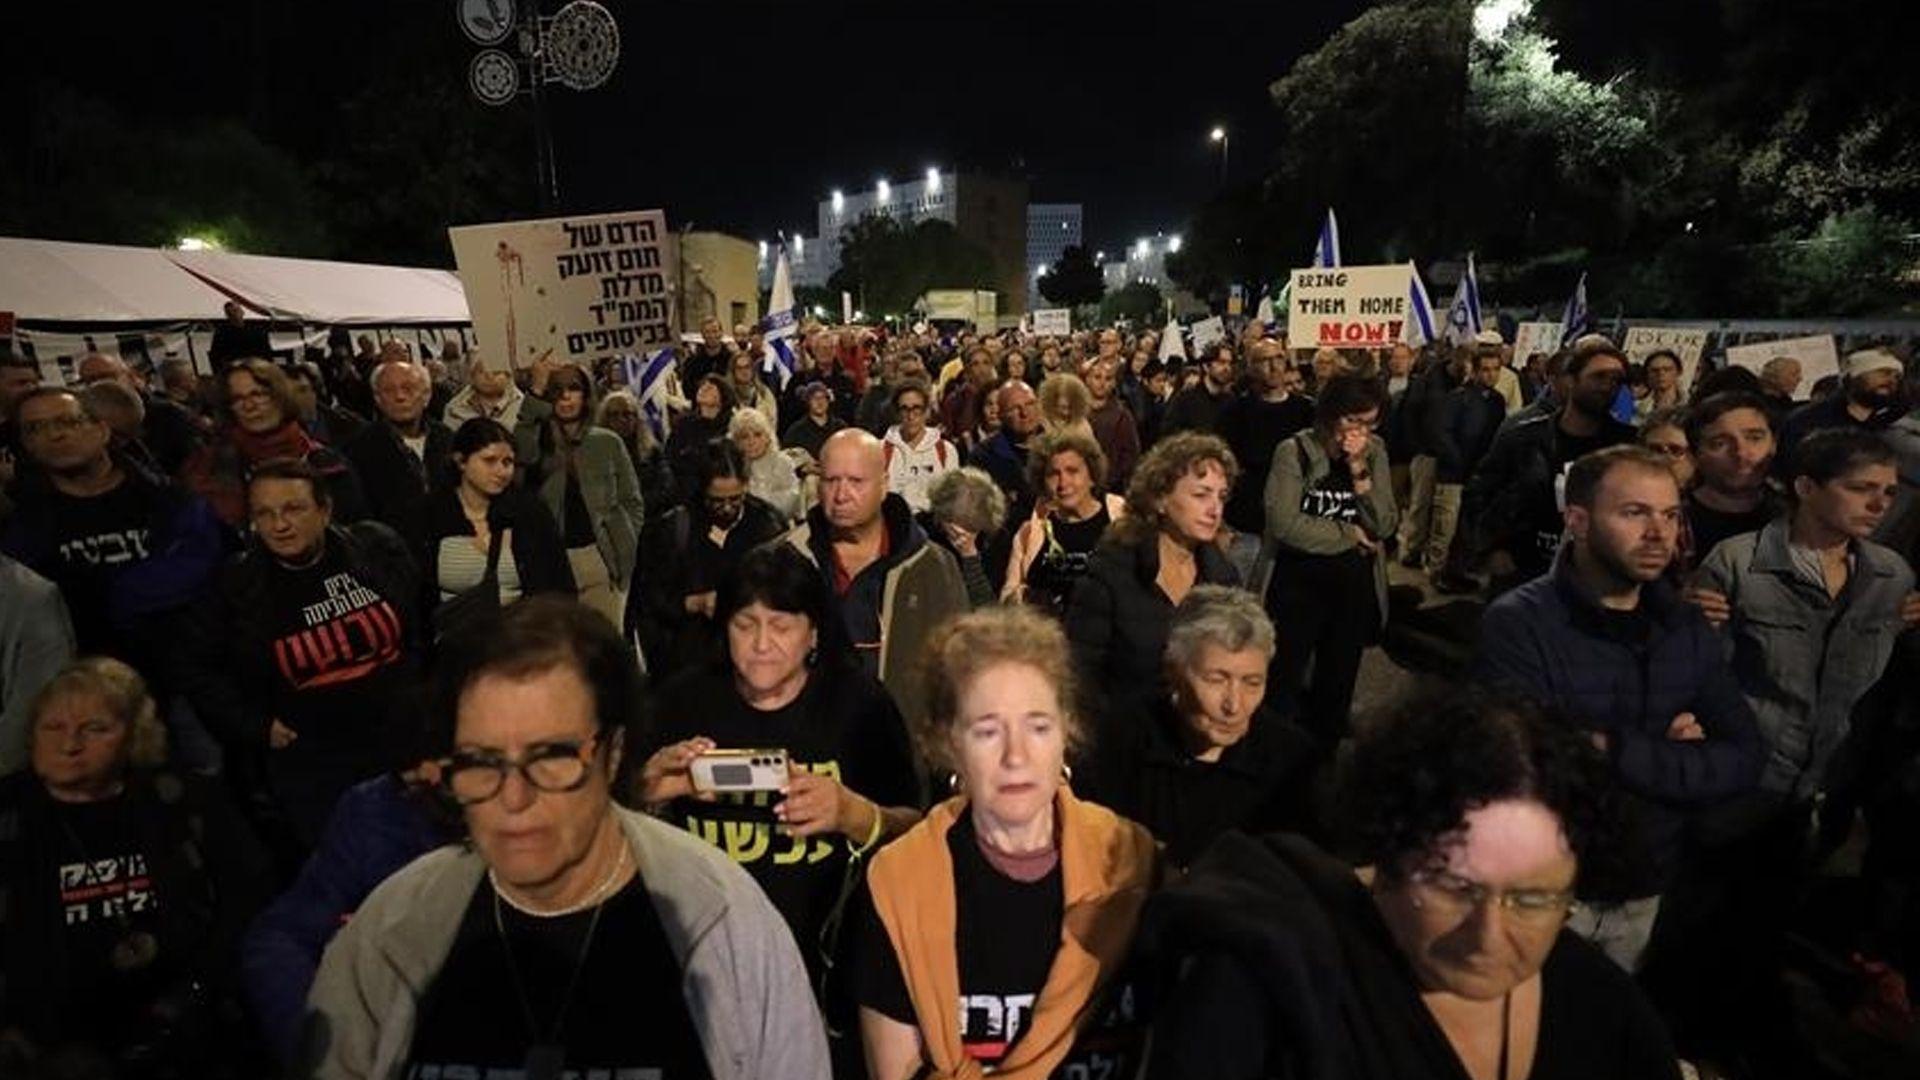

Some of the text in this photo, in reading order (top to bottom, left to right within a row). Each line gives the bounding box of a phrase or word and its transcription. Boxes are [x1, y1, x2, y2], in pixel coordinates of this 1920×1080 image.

[563, 220, 657, 248] הדם של
[557, 251, 612, 279] זועק
[602, 273, 664, 298] מדלת
[1298, 273, 1347, 288] BRING
[1299, 297, 1403, 313] THEM HOME
[567, 323, 673, 353] בכיסופים
